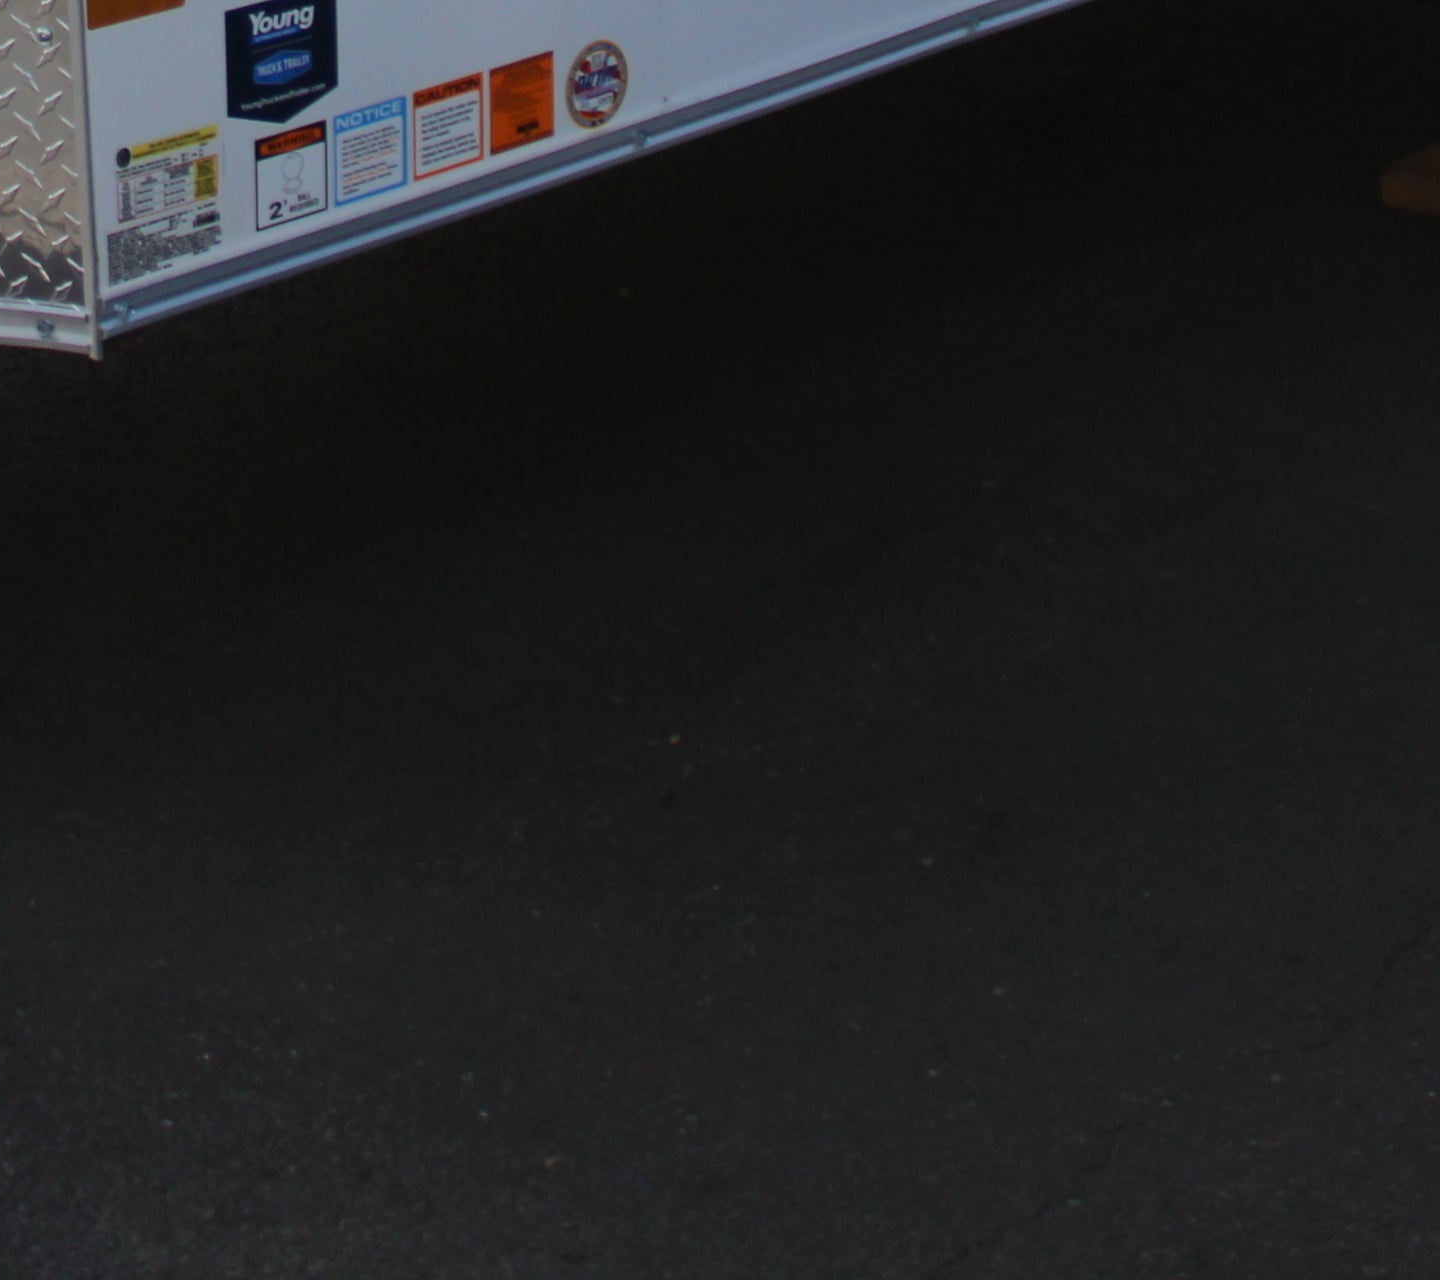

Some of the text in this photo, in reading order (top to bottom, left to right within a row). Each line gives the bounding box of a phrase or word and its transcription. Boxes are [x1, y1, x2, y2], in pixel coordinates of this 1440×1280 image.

[248, 4, 316, 37] Young
[415, 77, 481, 109] CAUTION
[335, 99, 403, 132] NOTICE
